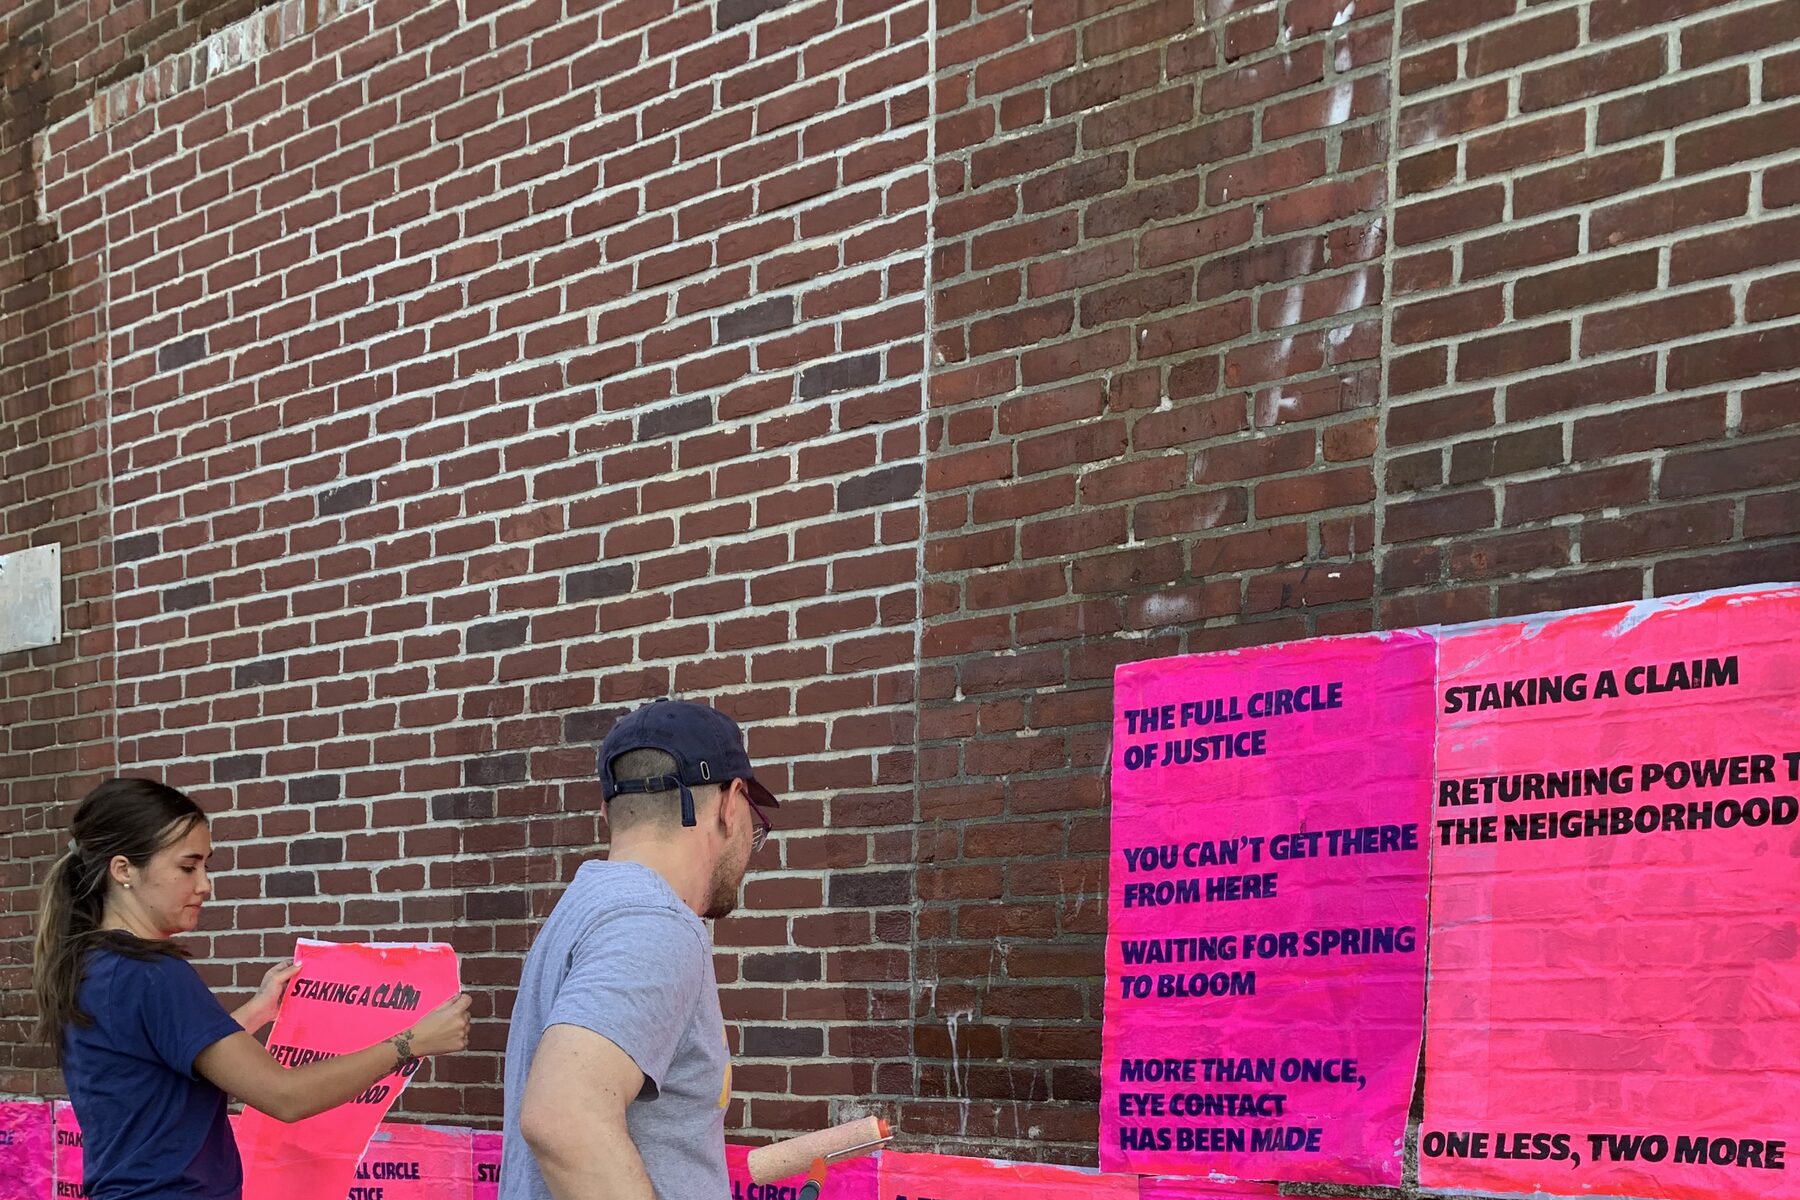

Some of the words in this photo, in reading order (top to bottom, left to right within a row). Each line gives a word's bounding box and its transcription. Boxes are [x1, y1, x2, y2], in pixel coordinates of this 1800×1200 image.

[1445, 674, 1586, 713] STAKING
[1594, 671, 1618, 698] A
[1625, 656, 1738, 695] CLAIM
[1125, 705, 1175, 734] THE
[1181, 697, 1242, 727] FULL
[1248, 683, 1342, 718] CIRCLE
[1124, 744, 1157, 770] OF
[1162, 730, 1266, 766] JUSTICE
[1439, 766, 1632, 806] RETURNING
[1641, 755, 1775, 791] POWER
[1783, 752, 1800, 780] T
[1437, 816, 1497, 845] THE
[1505, 796, 1798, 841] NEIGHBORHOOD
[1124, 845, 1178, 872] YOU
[1270, 832, 1323, 860] GET
[1326, 824, 1418, 856] THERE
[1124, 879, 1200, 907] FROM
[1206, 873, 1277, 902] HERE
[1122, 936, 1236, 964] WAITING
[1243, 932, 1298, 959] FOR
[1303, 926, 1415, 956] SPRING
[291, 978, 361, 1005] STAKING
[357, 986, 372, 1007] A
[372, 981, 422, 1011] CLAIM
[1121, 975, 1152, 998] TO
[1158, 971, 1255, 997] BLOOM
[1120, 1059, 1196, 1082] MORE
[1201, 1058, 1275, 1082] THAN
[1281, 1058, 1366, 1089] ONCE,
[1120, 1094, 1164, 1116] EYE
[1170, 1094, 1286, 1116] CONTACT
[1120, 1127, 1171, 1150] HAS
[1177, 1128, 1244, 1152] BEEN
[1251, 1127, 1322, 1152] MADE
[1423, 1132, 1488, 1158] ONE
[1495, 1133, 1580, 1167] LESS,
[1588, 1134, 1668, 1162] TWO
[1674, 1136, 1785, 1169] MORE
[372, 1162, 420, 1180] CIRCLE
